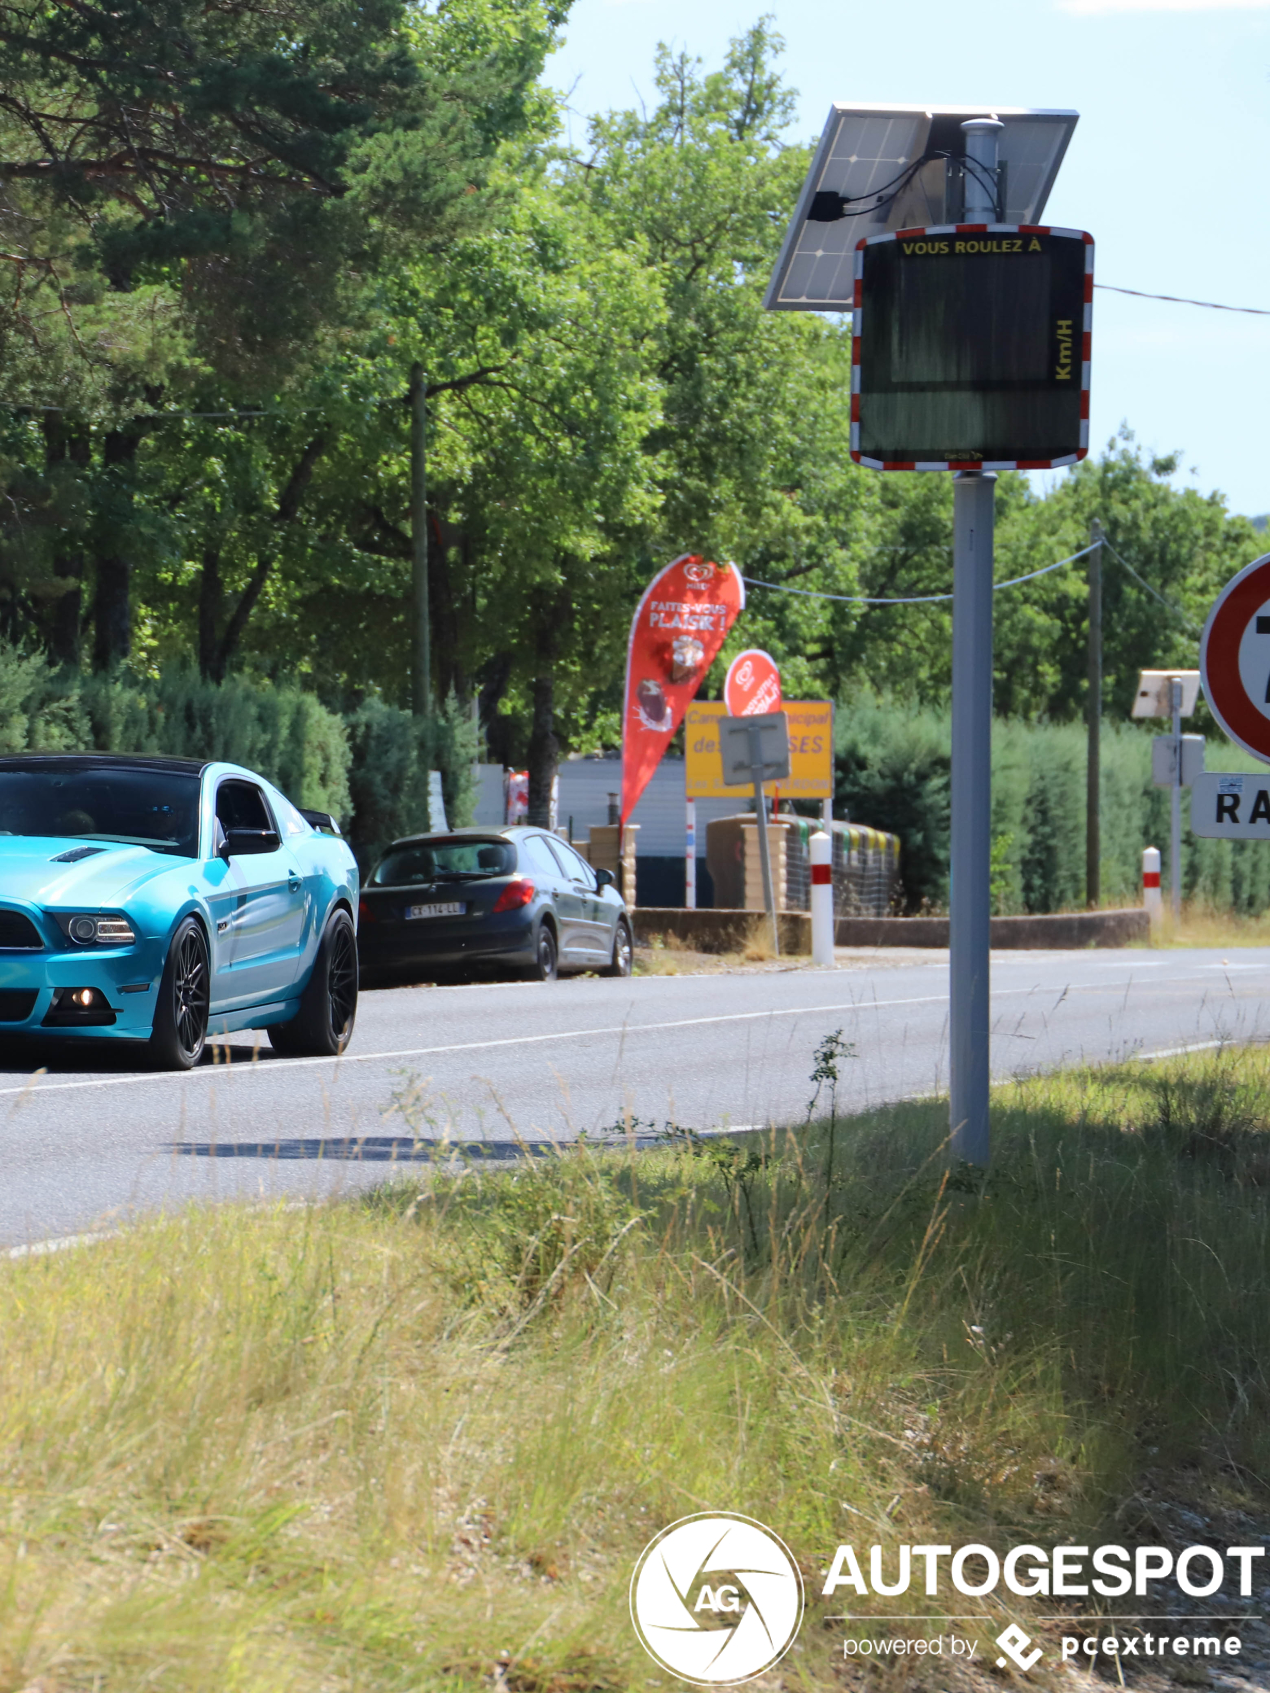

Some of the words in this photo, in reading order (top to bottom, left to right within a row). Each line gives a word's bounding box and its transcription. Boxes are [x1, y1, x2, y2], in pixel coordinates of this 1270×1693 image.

[902, 241, 949, 254] VOUS
[954, 239, 1022, 253] ROULEZ
[1028, 237, 1041, 251] À
[1055, 320, 1072, 380] Km/H
[649, 612, 714, 631] PLAISIR
